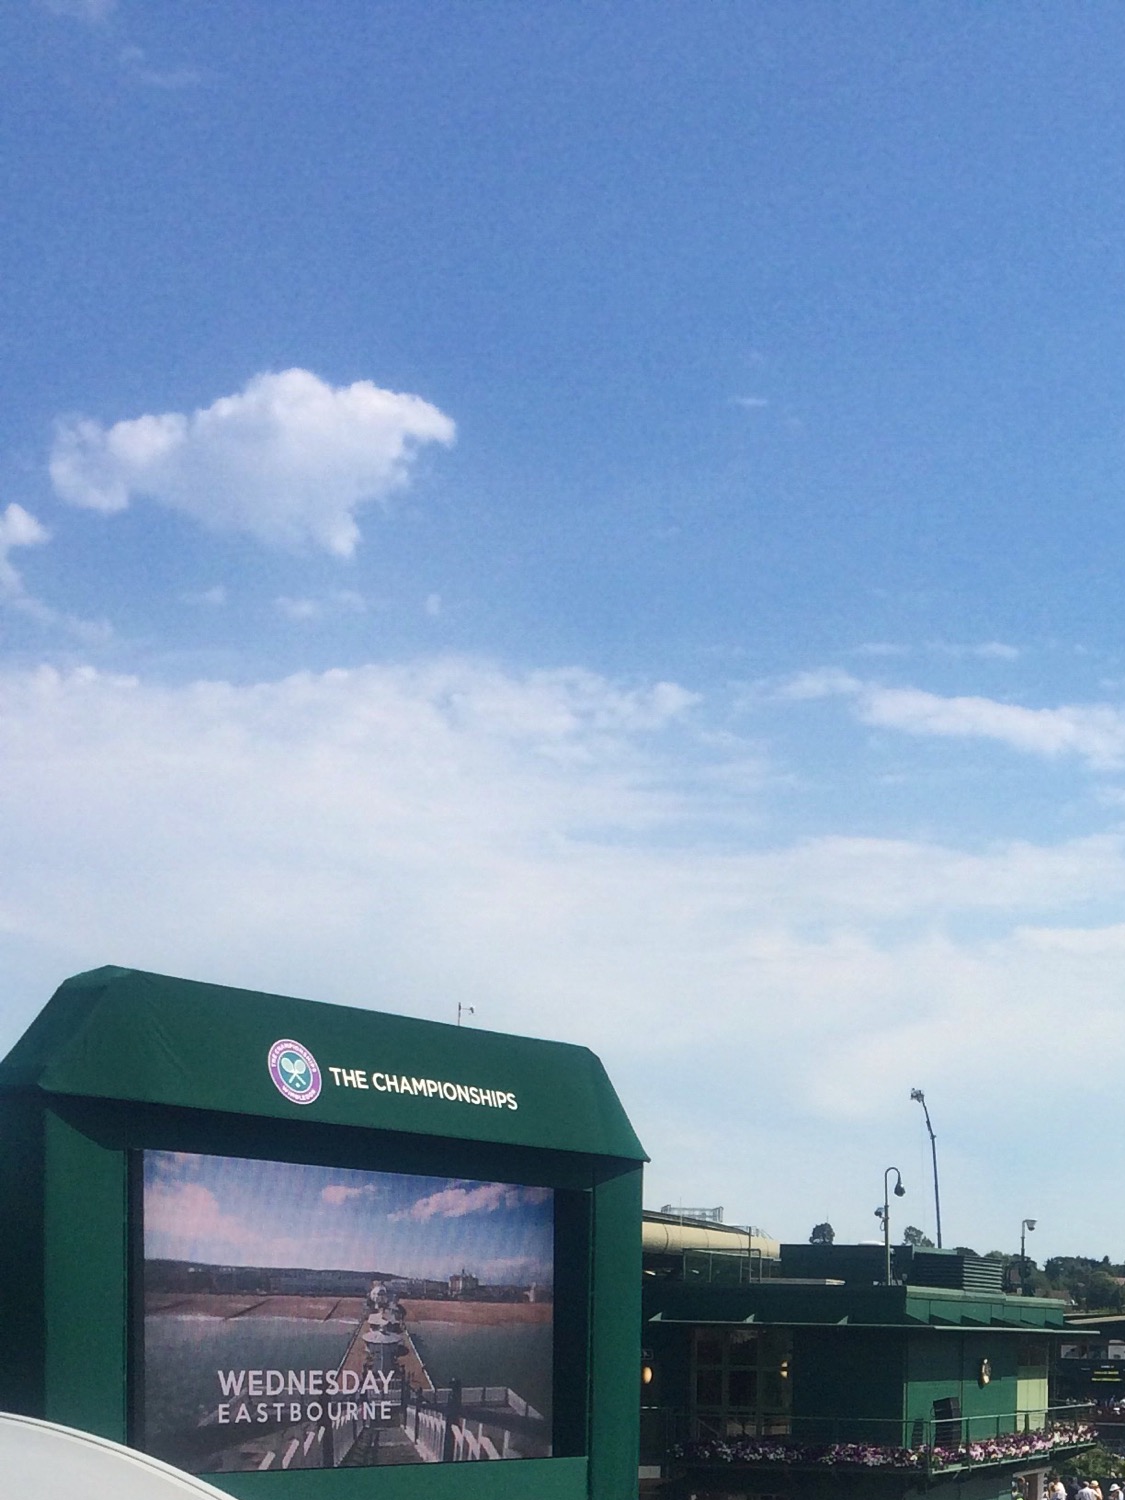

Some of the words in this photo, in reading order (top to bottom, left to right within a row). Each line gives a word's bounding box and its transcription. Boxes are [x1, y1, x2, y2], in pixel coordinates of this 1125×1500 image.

[329, 1066, 369, 1090] THE
[372, 1072, 518, 1110] CHAMPIONSHIPS
[217, 1370, 394, 1396] WEDNESDAY
[218, 1401, 392, 1424] EASTBOURNE
